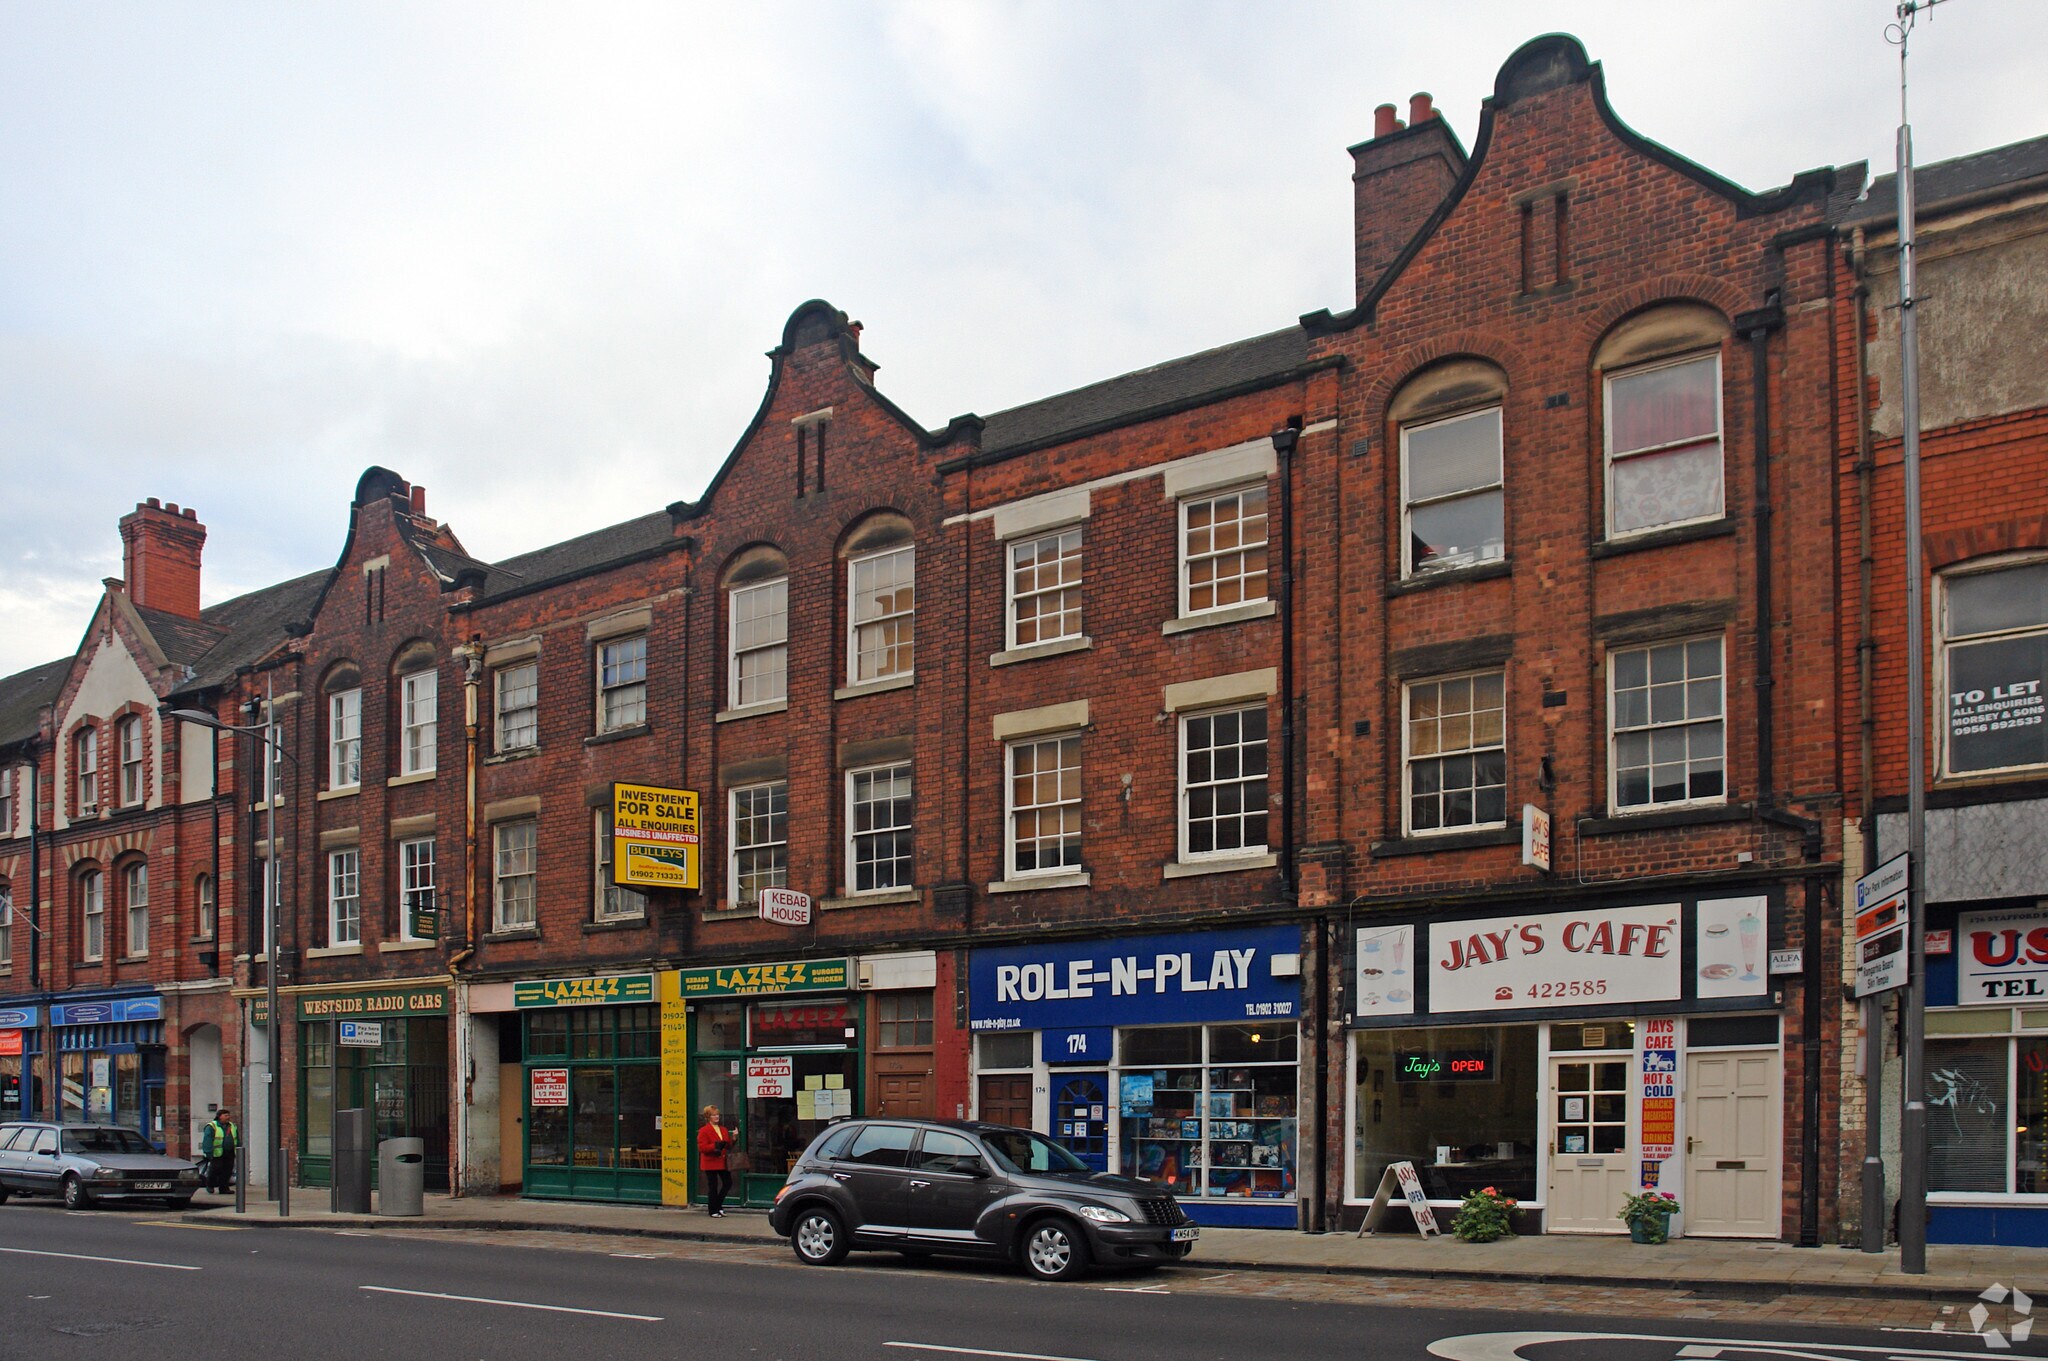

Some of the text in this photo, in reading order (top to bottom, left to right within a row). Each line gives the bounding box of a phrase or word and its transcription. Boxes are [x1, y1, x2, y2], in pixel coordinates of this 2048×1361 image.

[1951, 680, 2040, 706] TO LET
[1952, 695, 2043, 717] ALL ENQUIRIES
[1952, 705, 2046, 727] MORSEY & SONS
[1954, 715, 2042, 736] 0956 892533
[621, 789, 691, 805] INVESTMENT
[618, 801, 694, 820] FOR SALE
[618, 818, 695, 834] ALL ENQUIRIES
[615, 828, 698, 843] BUSINESS UNAFFECTED
[630, 846, 683, 859] BULLEYS
[630, 870, 654, 878] 01902
[1872, 881, 1880, 892] Park
[1881, 869, 1904, 888] Information
[772, 892, 808, 908] KEBAB
[771, 907, 808, 923] HOUSE
[1988, 912, 2040, 922] STAFFORD
[1441, 918, 1677, 971] JAY'S CAFÉ
[1772, 954, 1800, 963] ALFA
[716, 964, 806, 989] LAZEEZ
[812, 967, 844, 976] BURGERS
[812, 975, 844, 983] CHICKEN
[997, 948, 1256, 1002] ROLE-N-PLAY
[545, 978, 619, 1000] LAZEEZ
[735, 986, 759, 994] TAKE
[1527, 979, 1607, 999] 422585
[1982, 979, 2044, 998] TEL
[304, 994, 443, 1015] WESTSIDE RADIO CARS
[557, 997, 606, 1005] RESTAURANT
[759, 1005, 848, 1030] LAZEEZ
[971, 1017, 1021, 1030] www.role-n-play.co.uk
[1646, 1019, 1674, 1033] JAYS
[1066, 1034, 1087, 1053] 174
[1645, 1036, 1674, 1049] CAFE
[751, 1057, 788, 1066] Any Regular
[1404, 1057, 1485, 1078] Jay's OPEN
[763, 1066, 789, 1075] PIZZA
[1644, 1073, 1673, 1085] HOT &
[758, 1086, 782, 1095] £1.99
[1644, 1085, 1673, 1097] COLD
[1644, 1099, 1674, 1109] SNACKS
[1643, 1133, 1673, 1143] DRINKS
[1643, 1162, 1653, 1171] TEL
[1408, 1190, 1424, 1203] OPEN
